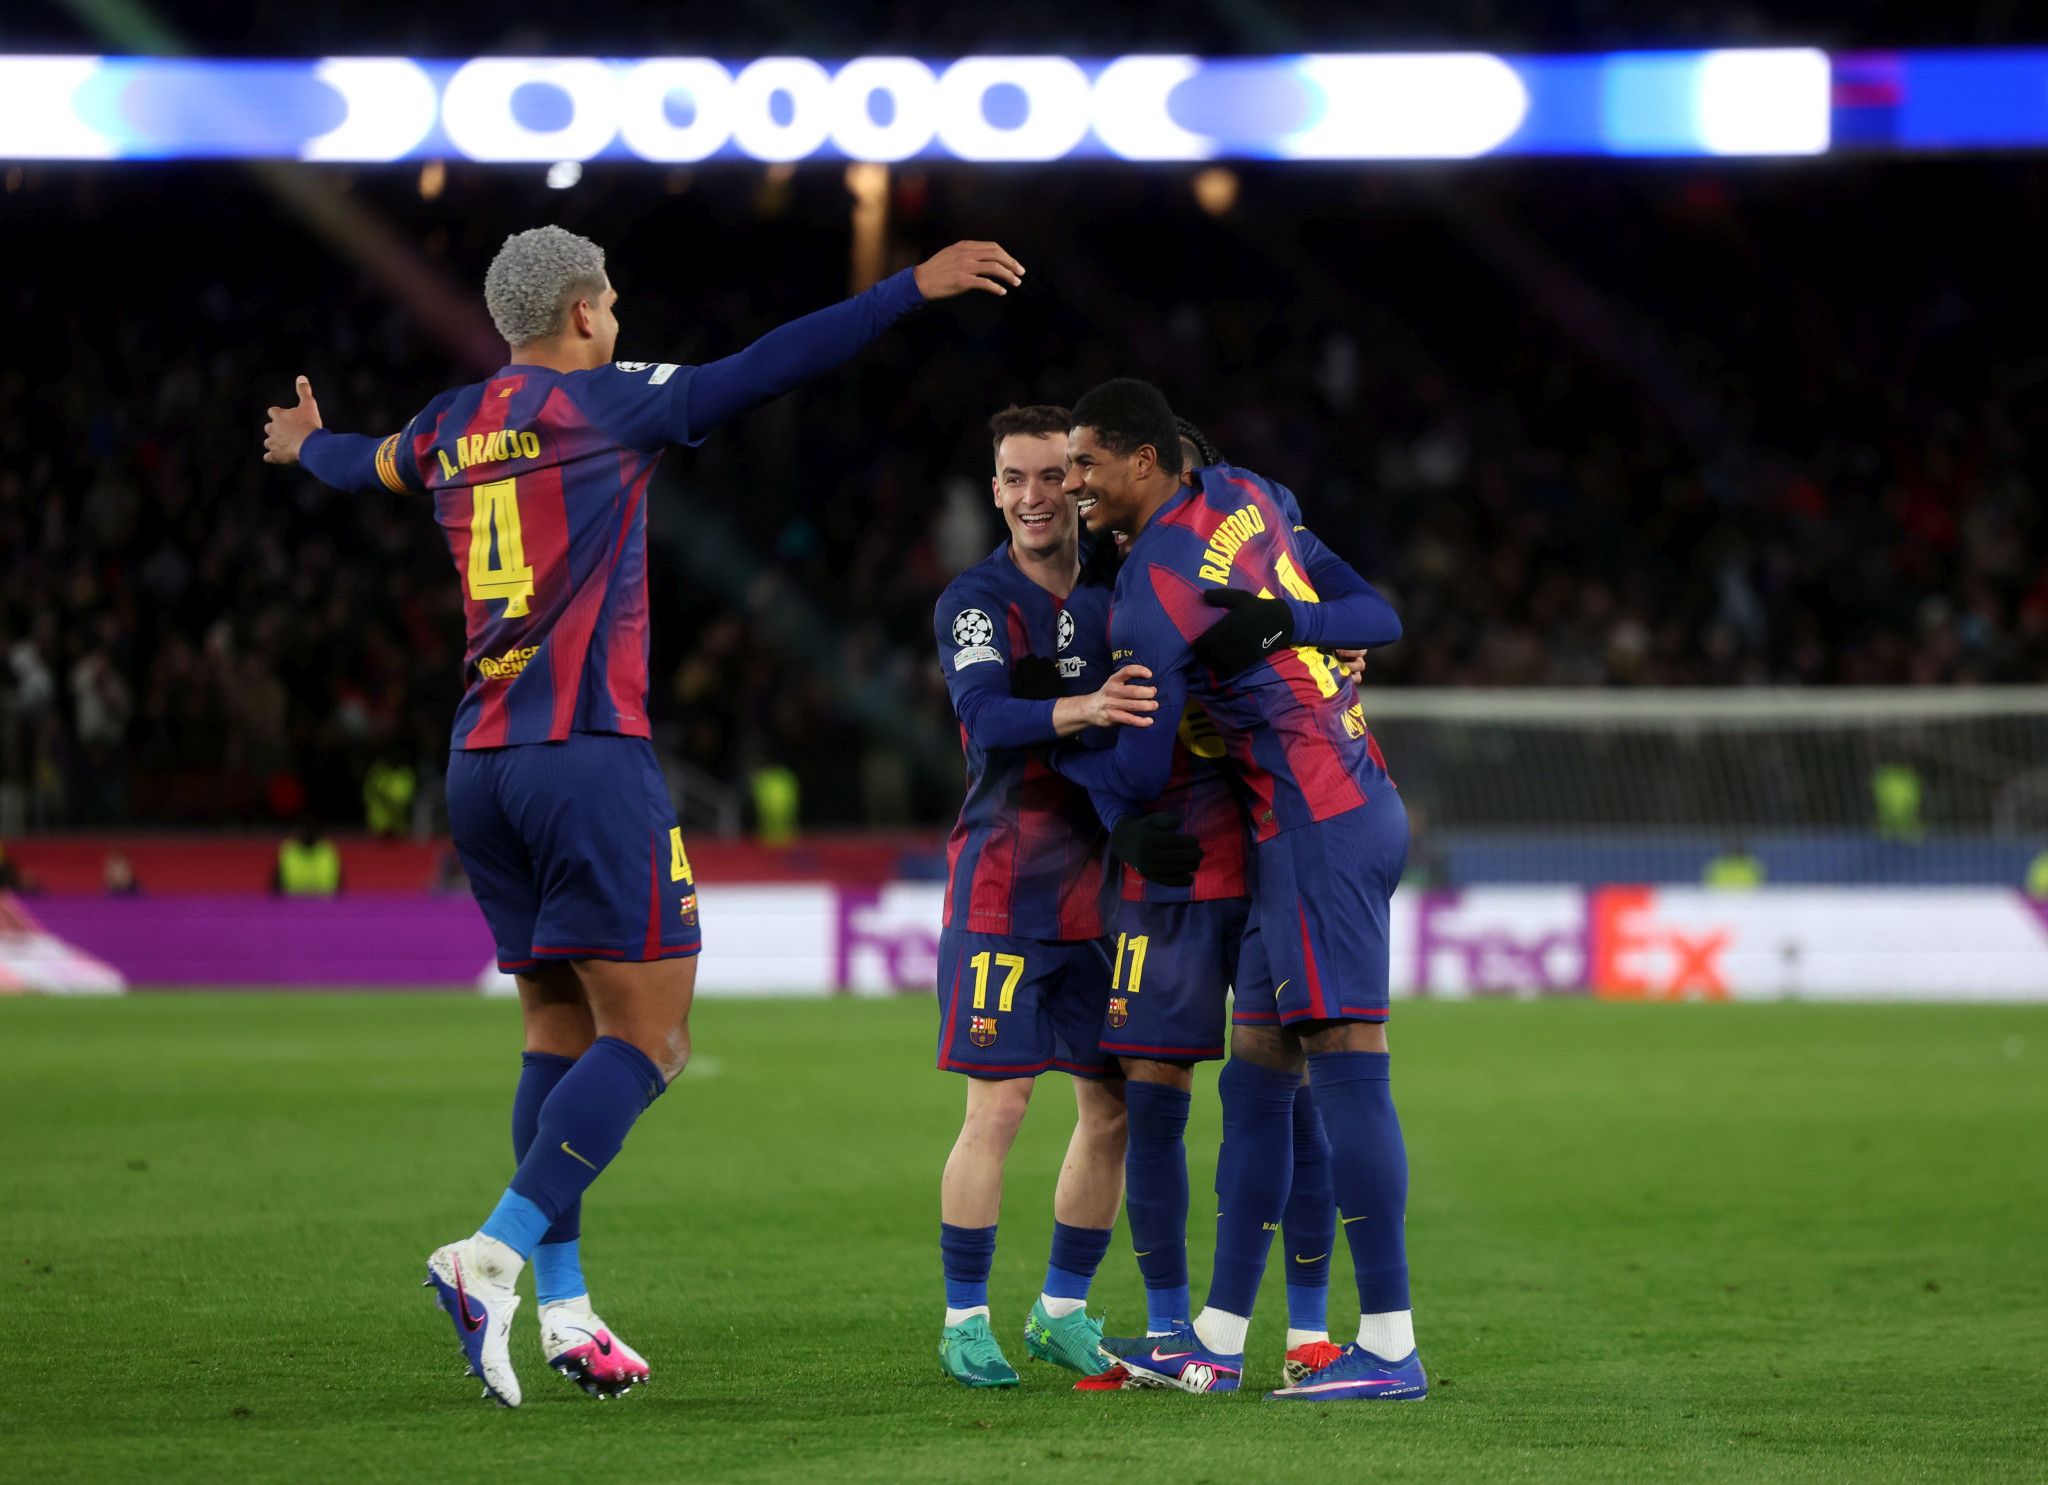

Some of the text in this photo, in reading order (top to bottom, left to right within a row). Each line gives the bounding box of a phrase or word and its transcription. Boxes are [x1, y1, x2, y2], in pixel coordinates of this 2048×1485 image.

[456, 429, 541, 470] ARAUJO
[468, 477, 534, 619] 4
[1198, 504, 1266, 586] RASHFORD
[669, 826, 694, 886] 4
[1112, 932, 1149, 993] 11
[1412, 886, 1734, 1000] FedEx
[970, 951, 1025, 1012] 17
